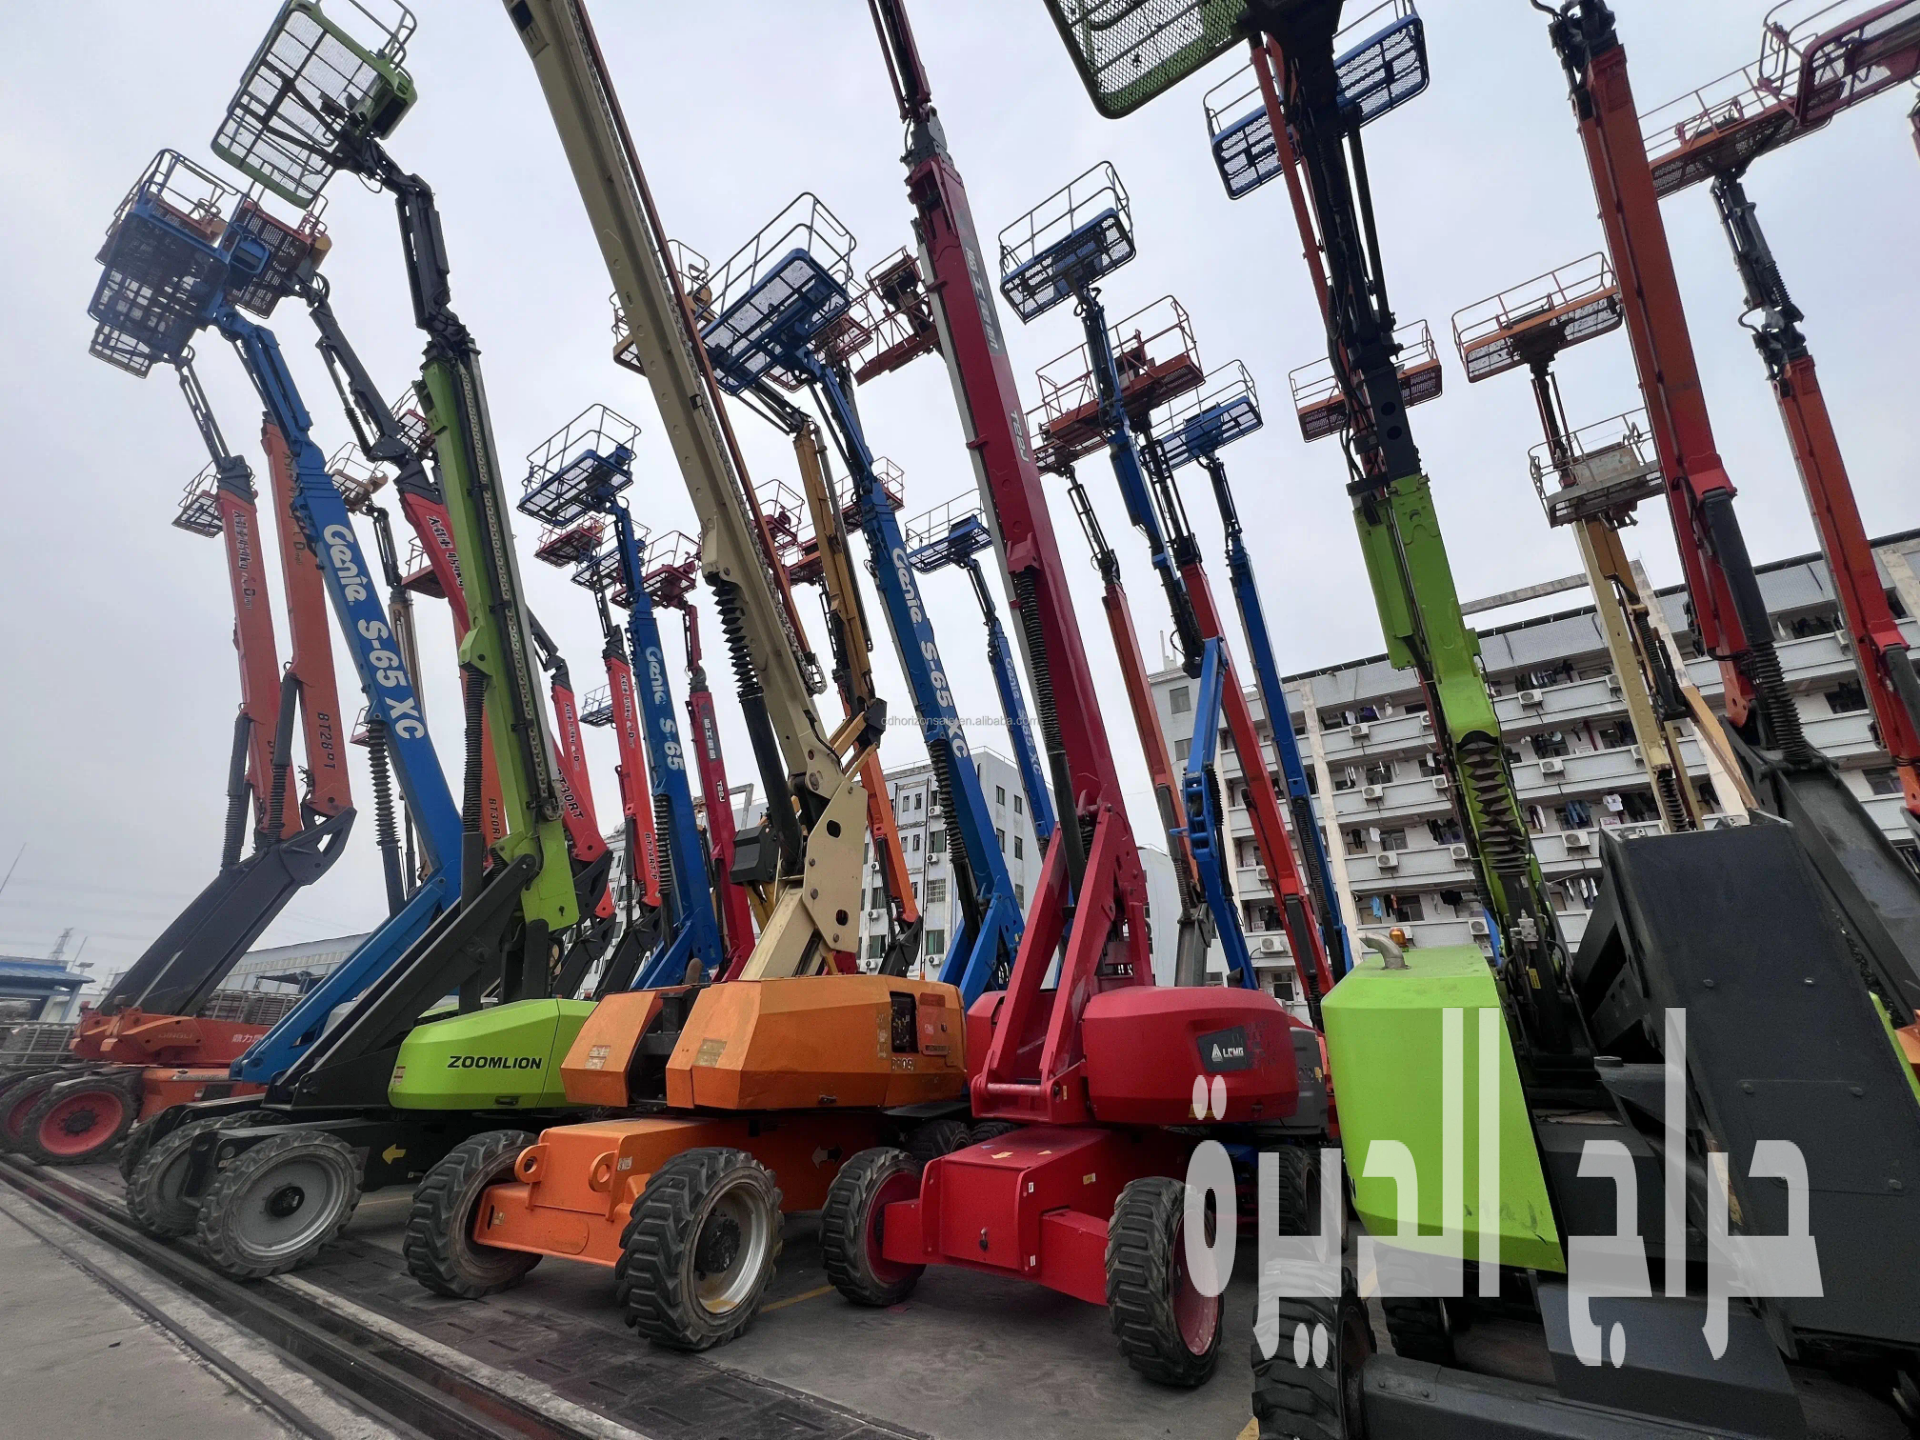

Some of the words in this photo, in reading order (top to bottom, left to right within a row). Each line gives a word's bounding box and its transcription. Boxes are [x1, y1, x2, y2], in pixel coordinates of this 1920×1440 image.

[323, 524, 368, 605] Genie
[357, 618, 408, 688] S-65
[385, 696, 425, 739] XC
[892, 548, 922, 626] Genie
[921, 641, 953, 708] S-65
[946, 717, 968, 759] XC
[646, 646, 665, 705] Genie
[1005, 657, 1020, 699] Genie
[557, 768, 585, 820] T30RT
[447, 1055, 543, 1069] ZOOMLION
